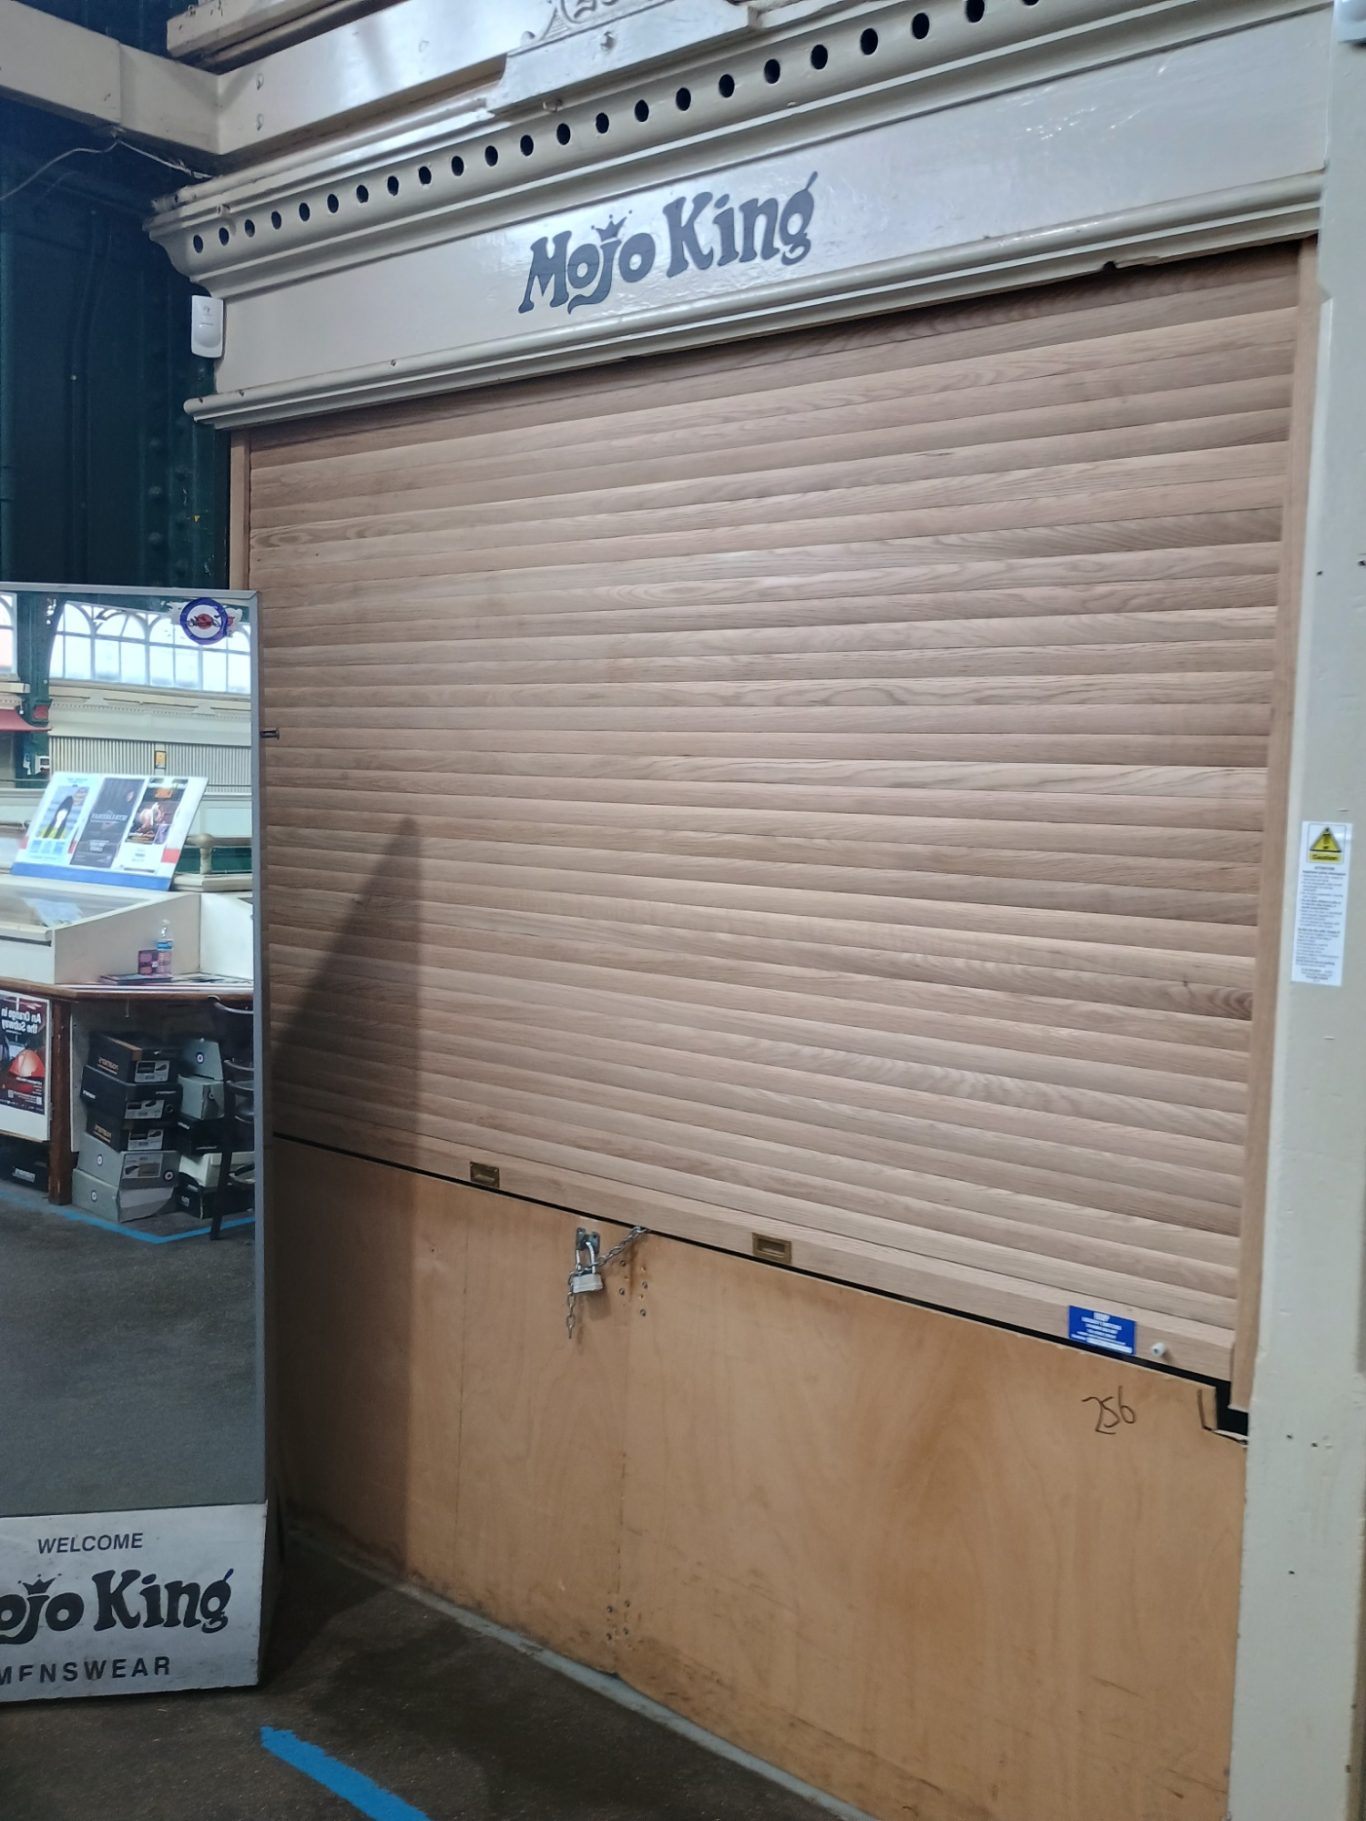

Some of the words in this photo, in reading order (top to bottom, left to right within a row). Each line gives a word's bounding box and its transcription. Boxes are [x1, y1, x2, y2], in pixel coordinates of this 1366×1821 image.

[518, 210, 656, 314] Mojo
[663, 171, 819, 278] King
[38, 1532, 144, 1554] WELCOME
[0, 1573, 85, 1645] ojo
[91, 1568, 235, 1634] King
